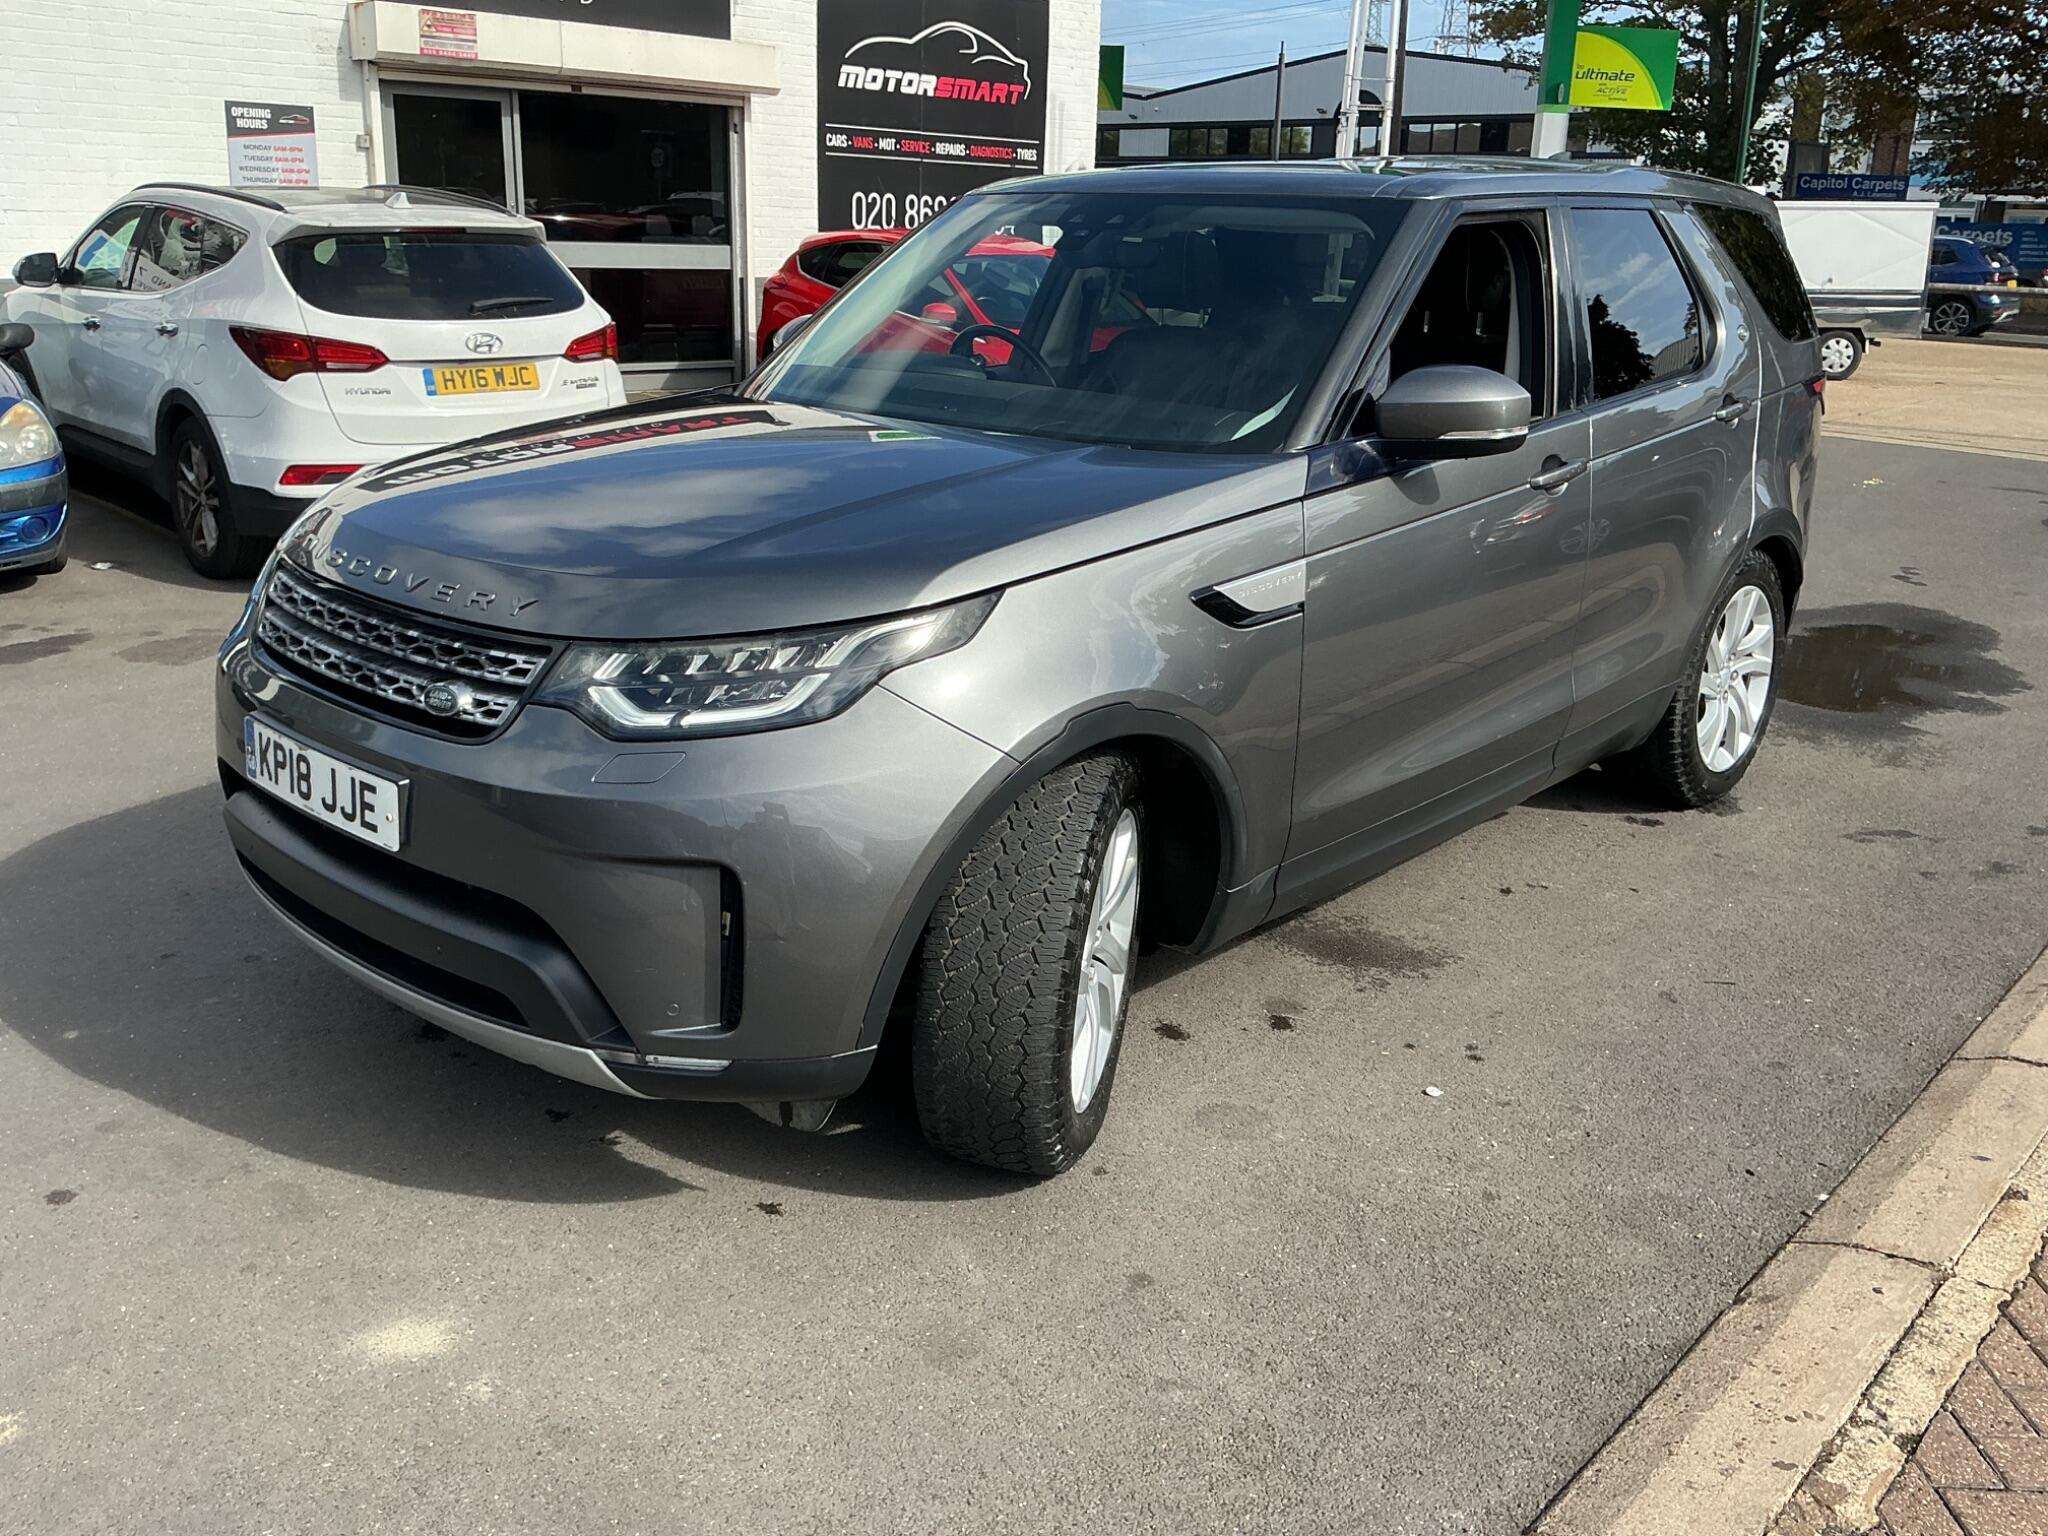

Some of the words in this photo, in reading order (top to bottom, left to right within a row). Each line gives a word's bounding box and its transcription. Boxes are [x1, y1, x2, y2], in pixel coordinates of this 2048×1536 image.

[1575, 68, 1635, 81] ultimate
[837, 64, 1024, 105] MOTORSMART
[231, 106, 271, 118] OPENING
[236, 118, 268, 129] HOURS
[826, 133, 847, 148] CARS
[853, 136, 873, 149] VANS
[879, 138, 896, 151] MOT
[901, 140, 930, 154] SERVICE
[935, 143, 966, 157] REPAIRS
[970, 145, 1013, 159] DIAGNOSTICS
[1017, 148, 1037, 161] TYRES
[239, 165, 279, 173] WEDNESDAY
[242, 176, 277, 184] THURSDAY
[1800, 176, 1848, 190] Capitol
[1851, 177, 1906, 192] Carpets
[852, 191, 896, 230] 020
[905, 193, 956, 230] 86
[442, 368, 488, 390] HY16
[494, 366, 532, 387] WJC
[345, 387, 392, 396] HYUNDAI
[258, 732, 312, 801] KP18
[320, 768, 379, 834] JJE
